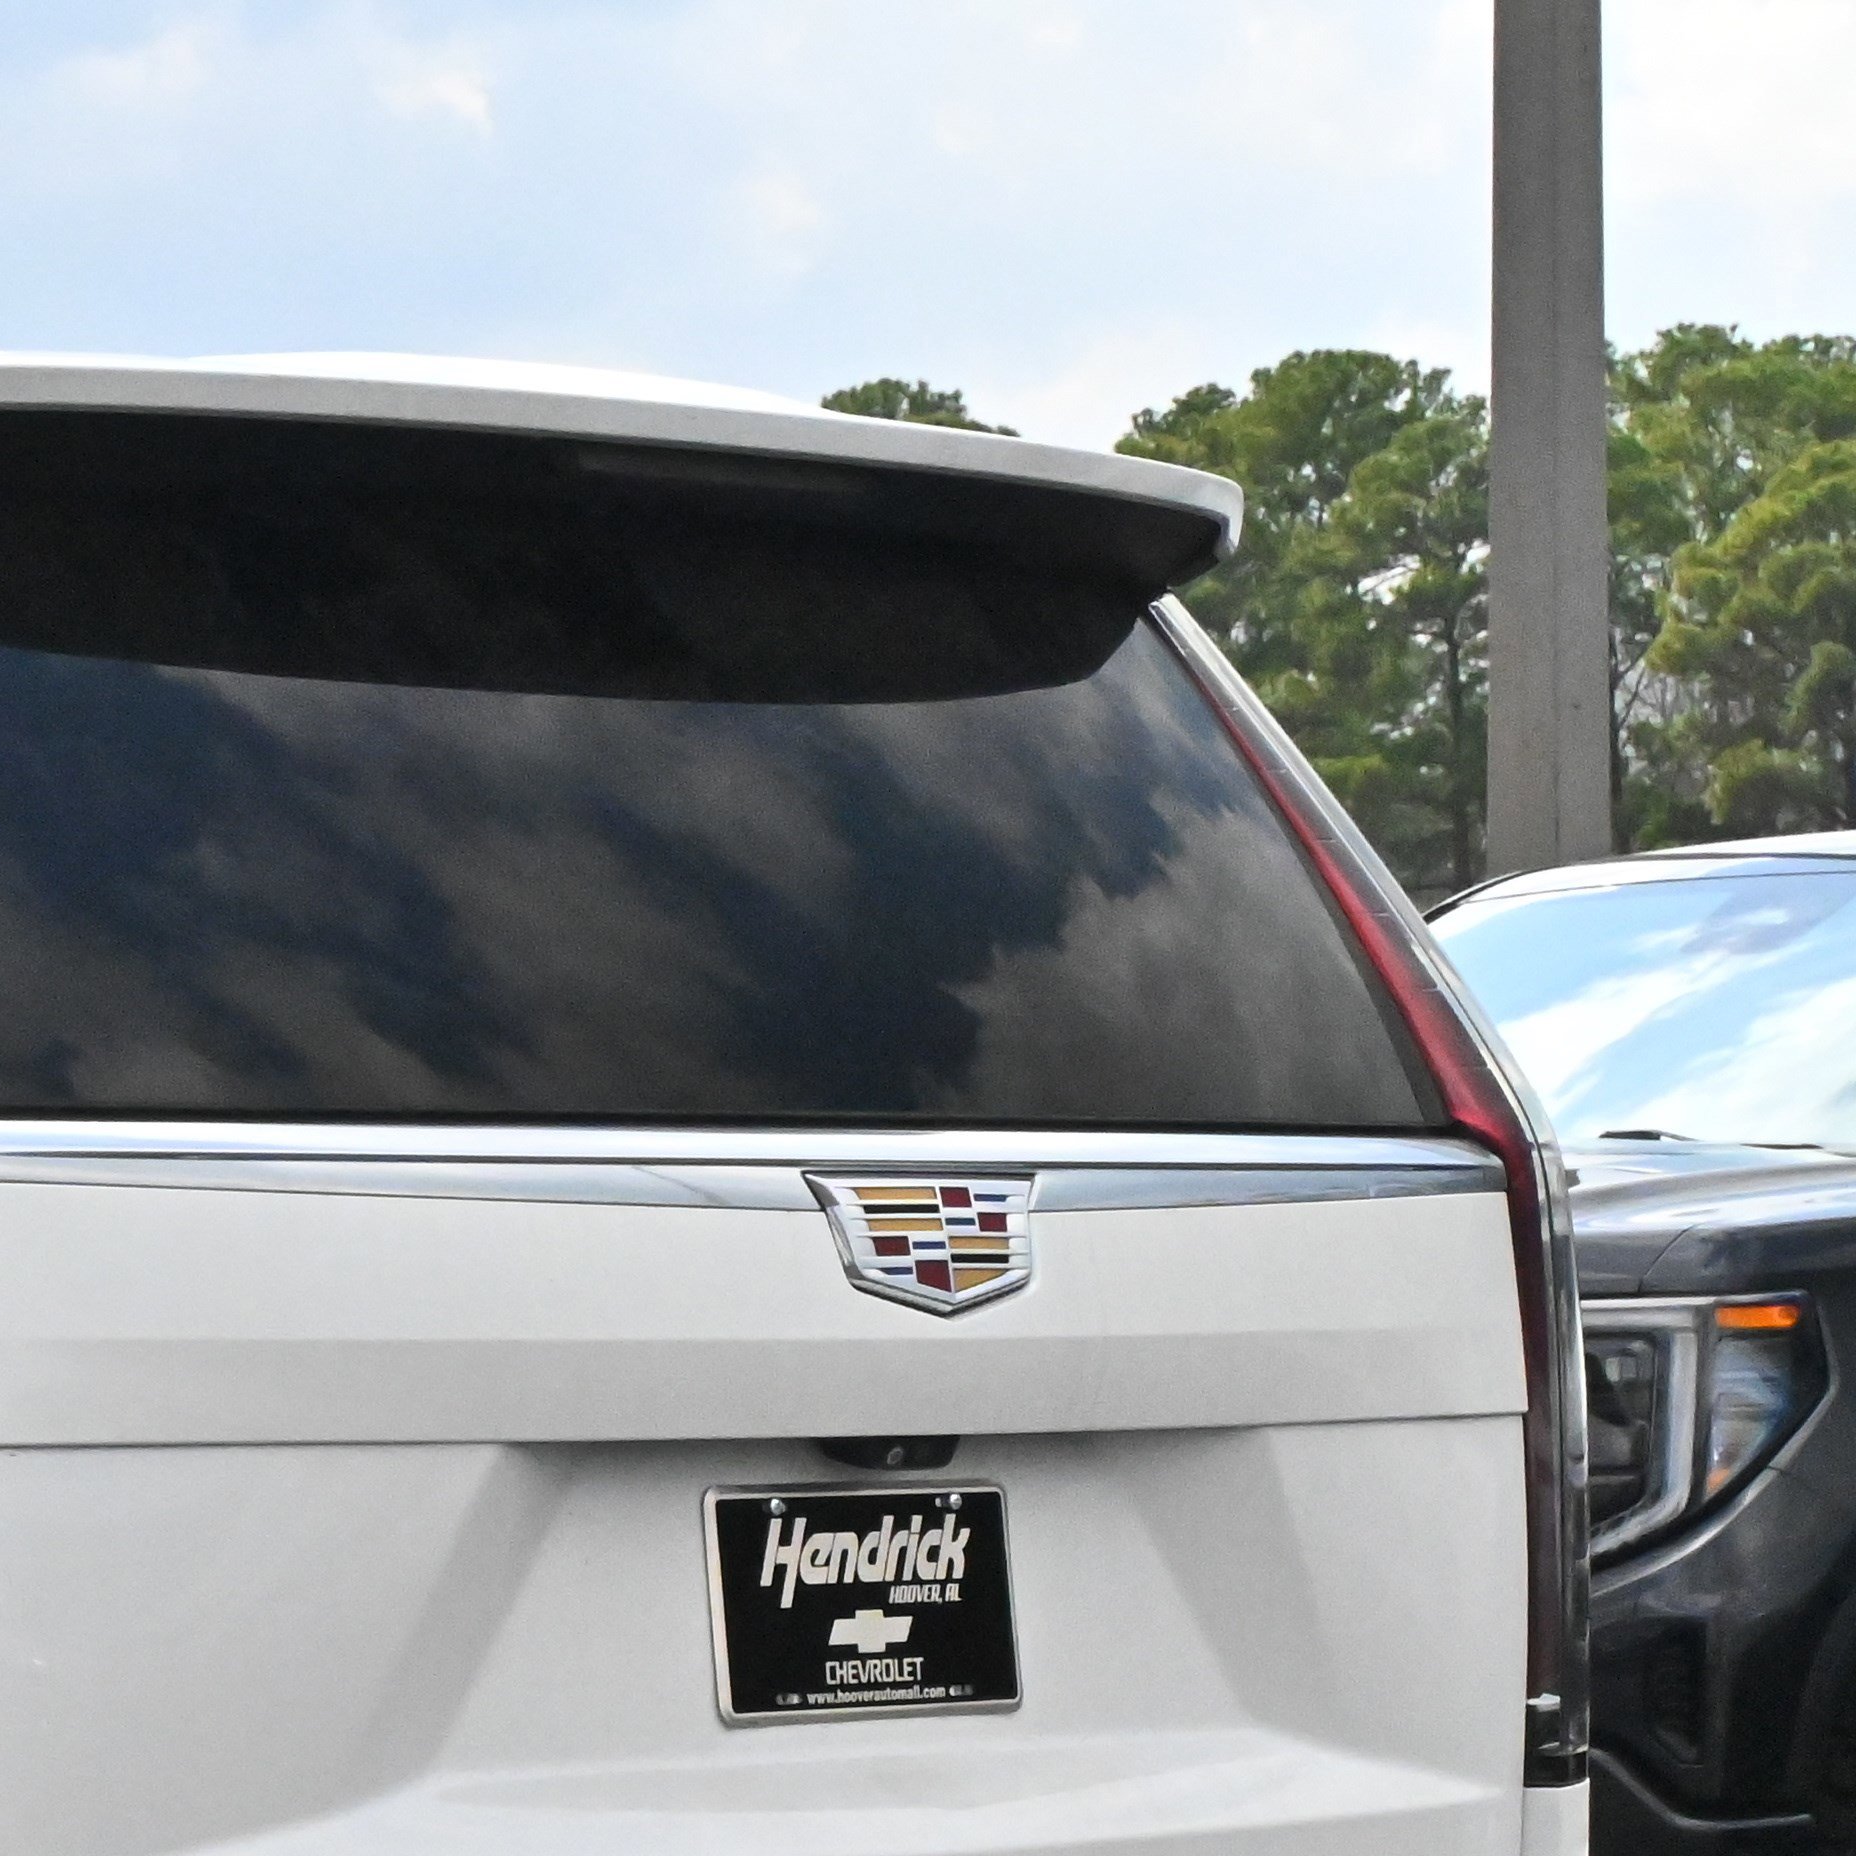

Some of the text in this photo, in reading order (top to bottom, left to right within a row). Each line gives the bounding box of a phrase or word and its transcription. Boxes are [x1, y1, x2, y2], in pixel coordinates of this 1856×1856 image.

[759, 1514, 971, 1609] Hendrick
[888, 1583, 962, 1605] HOOVER, AL
[825, 1657, 924, 1685] CHEVROLET
[806, 1684, 946, 1705] www.hooverautomall.com
